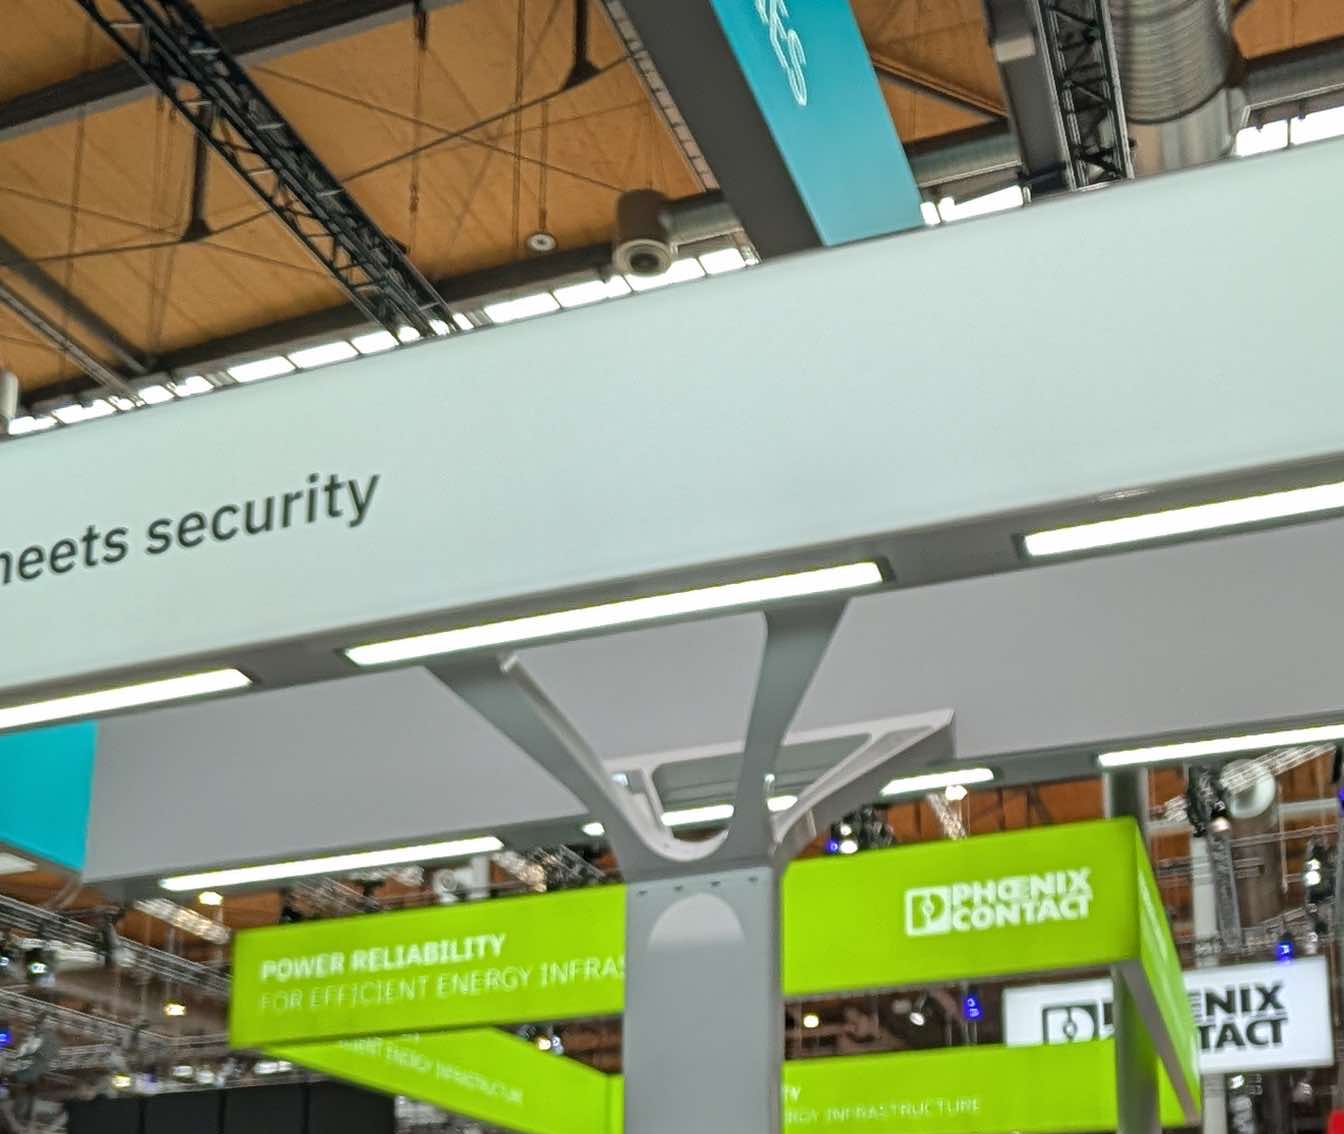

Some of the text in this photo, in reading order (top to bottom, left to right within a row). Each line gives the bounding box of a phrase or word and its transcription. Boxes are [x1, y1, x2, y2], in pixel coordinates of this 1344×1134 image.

[145, 473, 380, 556] security
[951, 896, 1094, 932] CONTACT
[260, 933, 506, 981] POWER RELIABILITY
[260, 990, 303, 1010] FOR
[310, 974, 429, 1009] EFFICIENT
[436, 966, 533, 998] ENERGY
